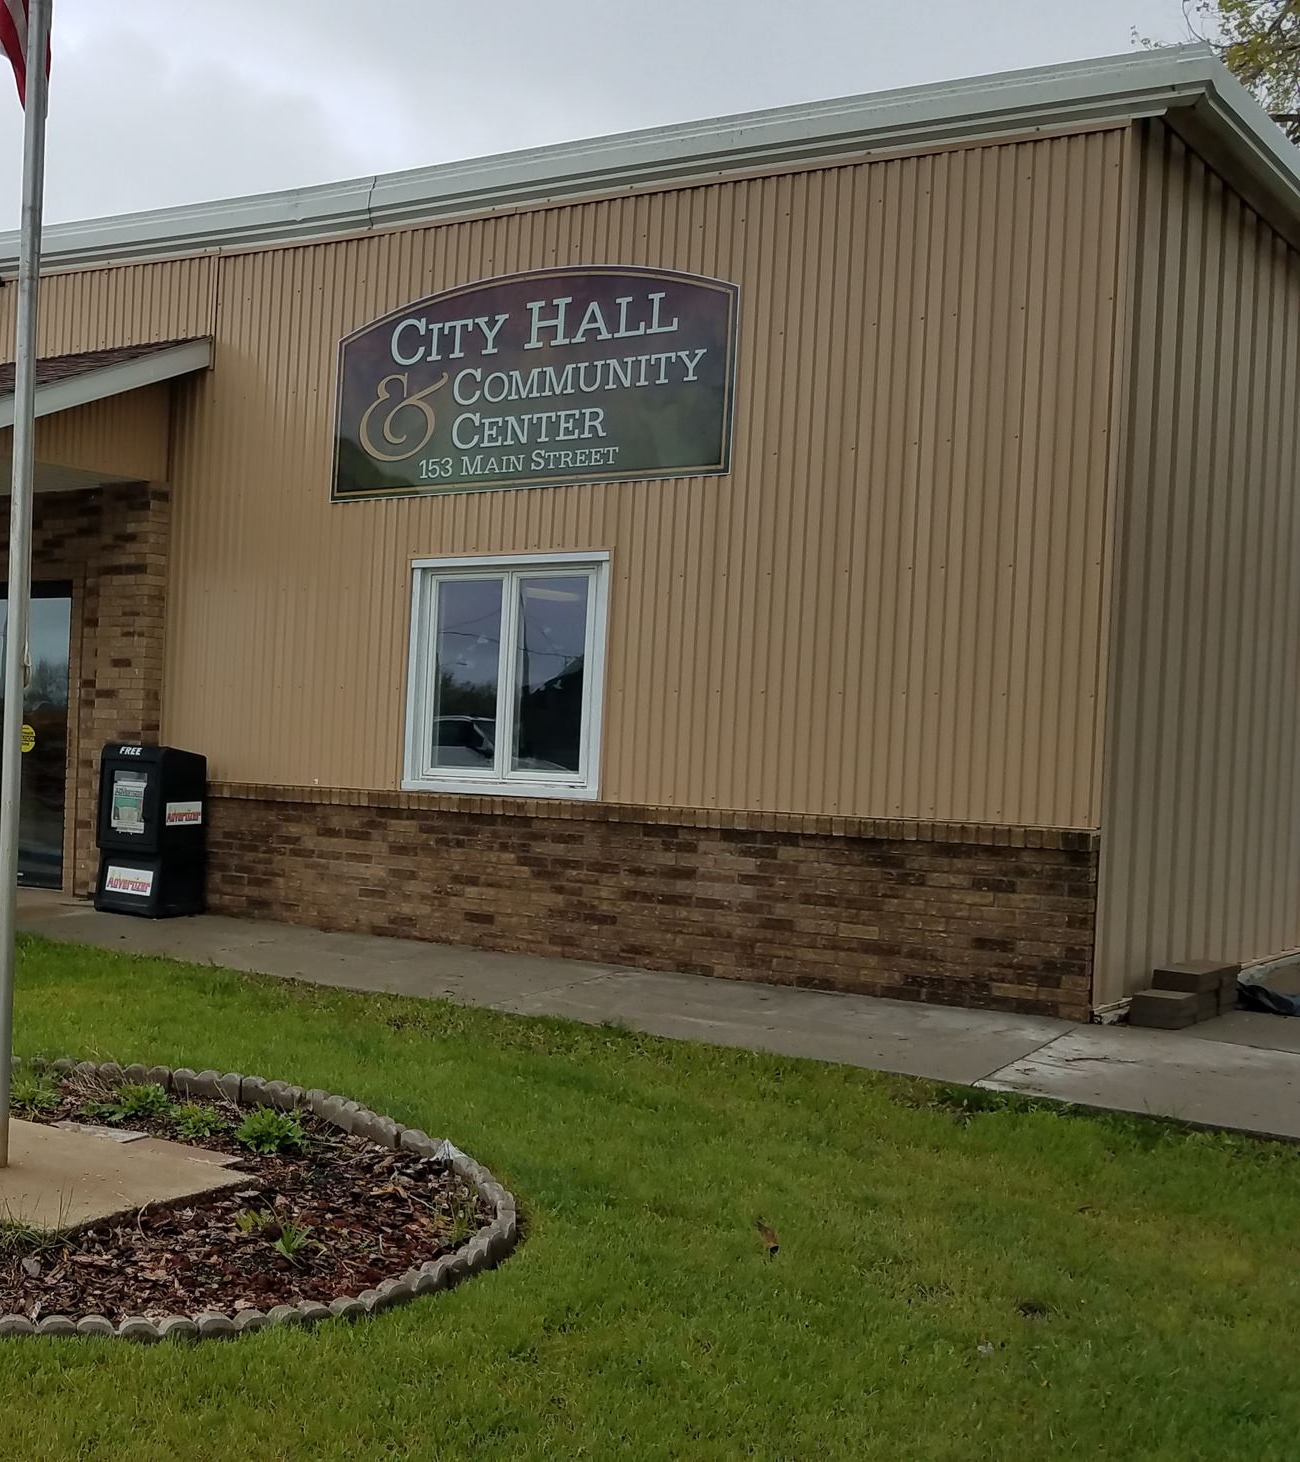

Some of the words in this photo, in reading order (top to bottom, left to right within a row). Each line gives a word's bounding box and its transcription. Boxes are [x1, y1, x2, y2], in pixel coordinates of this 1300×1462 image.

[390, 312, 509, 366] CITY
[523, 292, 680, 350] HALL
[358, 372, 448, 462] &
[452, 348, 707, 406] COMMUNITY
[451, 406, 607, 450] CENTER
[418, 457, 453, 479] 153
[460, 454, 525, 476] MAIN
[530, 446, 619, 472] STREET
[119, 746, 143, 756] FREE
